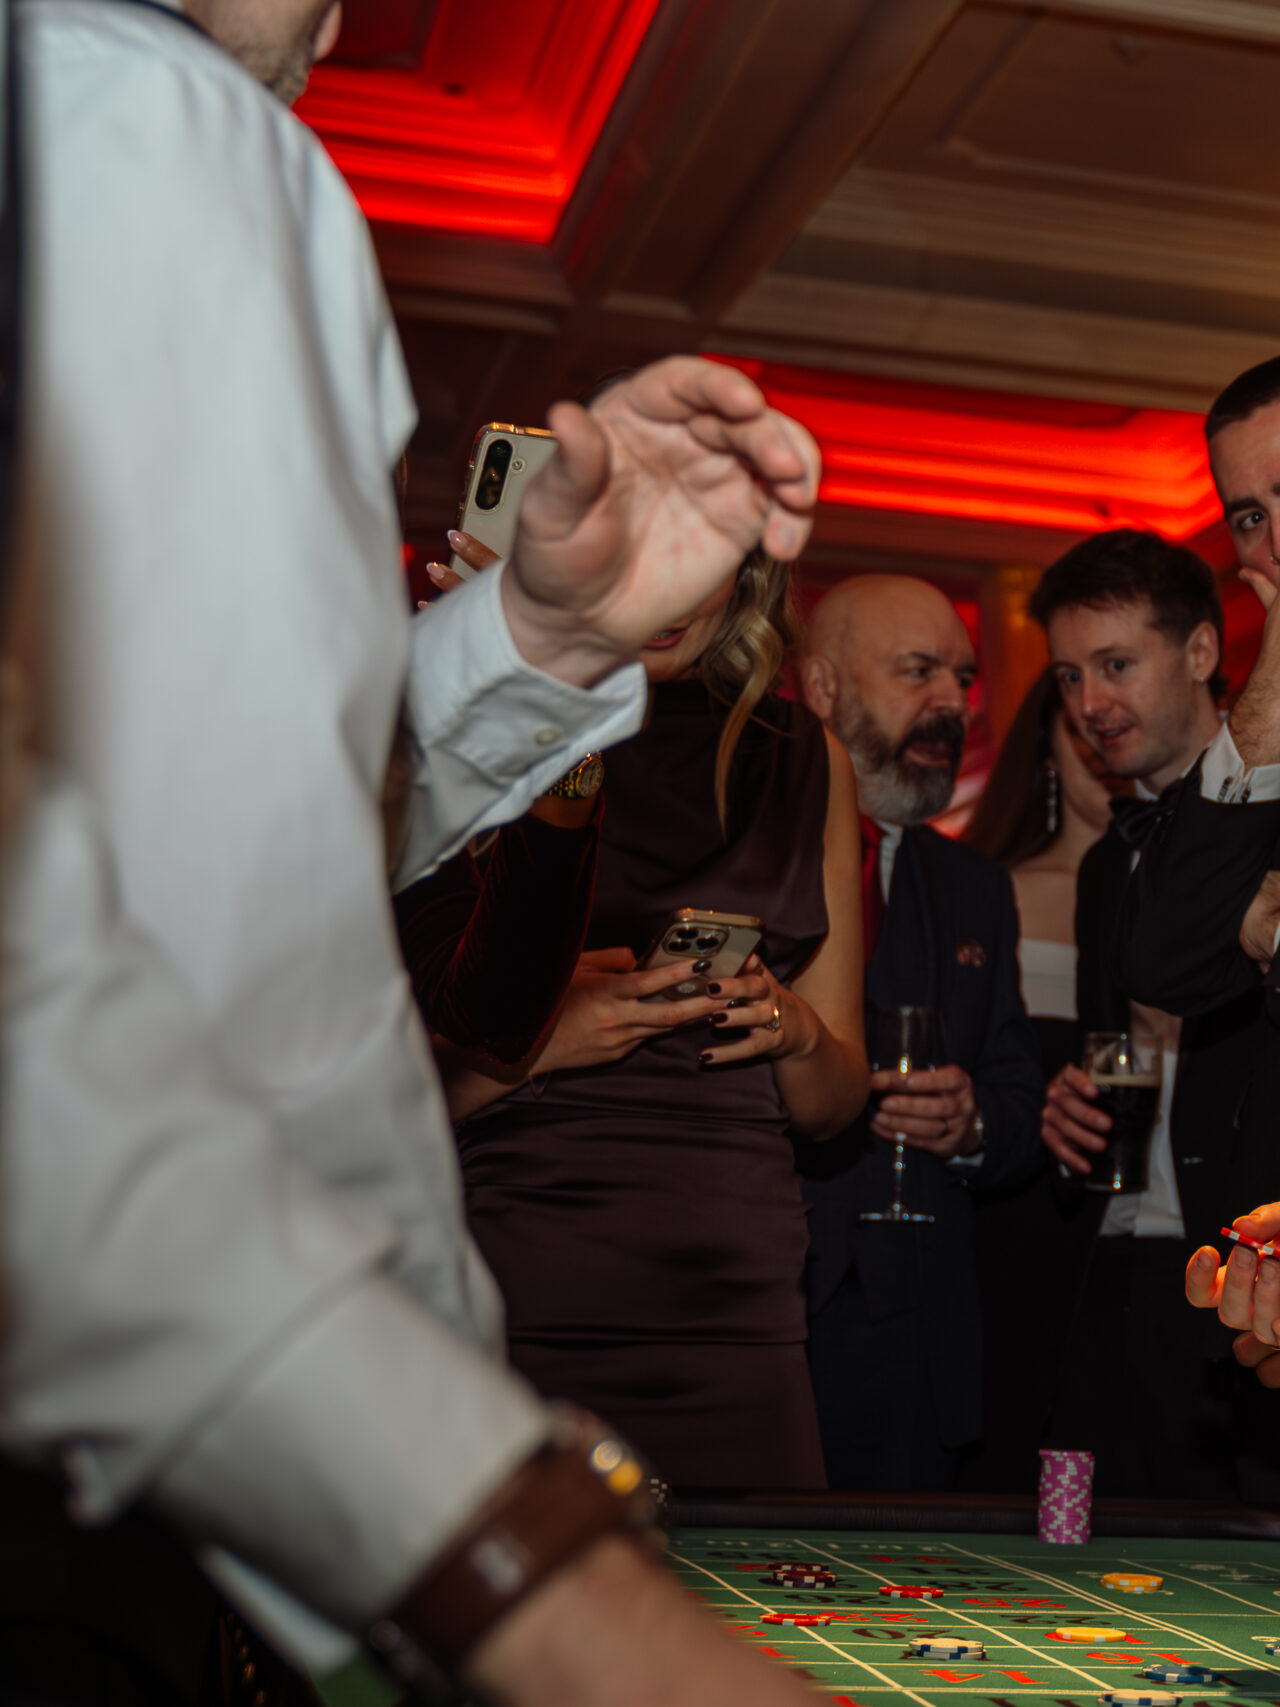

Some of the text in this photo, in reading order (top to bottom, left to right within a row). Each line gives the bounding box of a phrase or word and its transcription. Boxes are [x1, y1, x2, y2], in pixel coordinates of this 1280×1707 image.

[927, 1580, 1031, 1592] 28
[784, 1594, 891, 1605] 26
[962, 1598, 1068, 1608] 25
[817, 1611, 929, 1623] 23
[1000, 1614, 1113, 1625] 22
[852, 1628, 967, 1640] 20
[1085, 1652, 1201, 1665] 16
[918, 1669, 1049, 1685] 14
